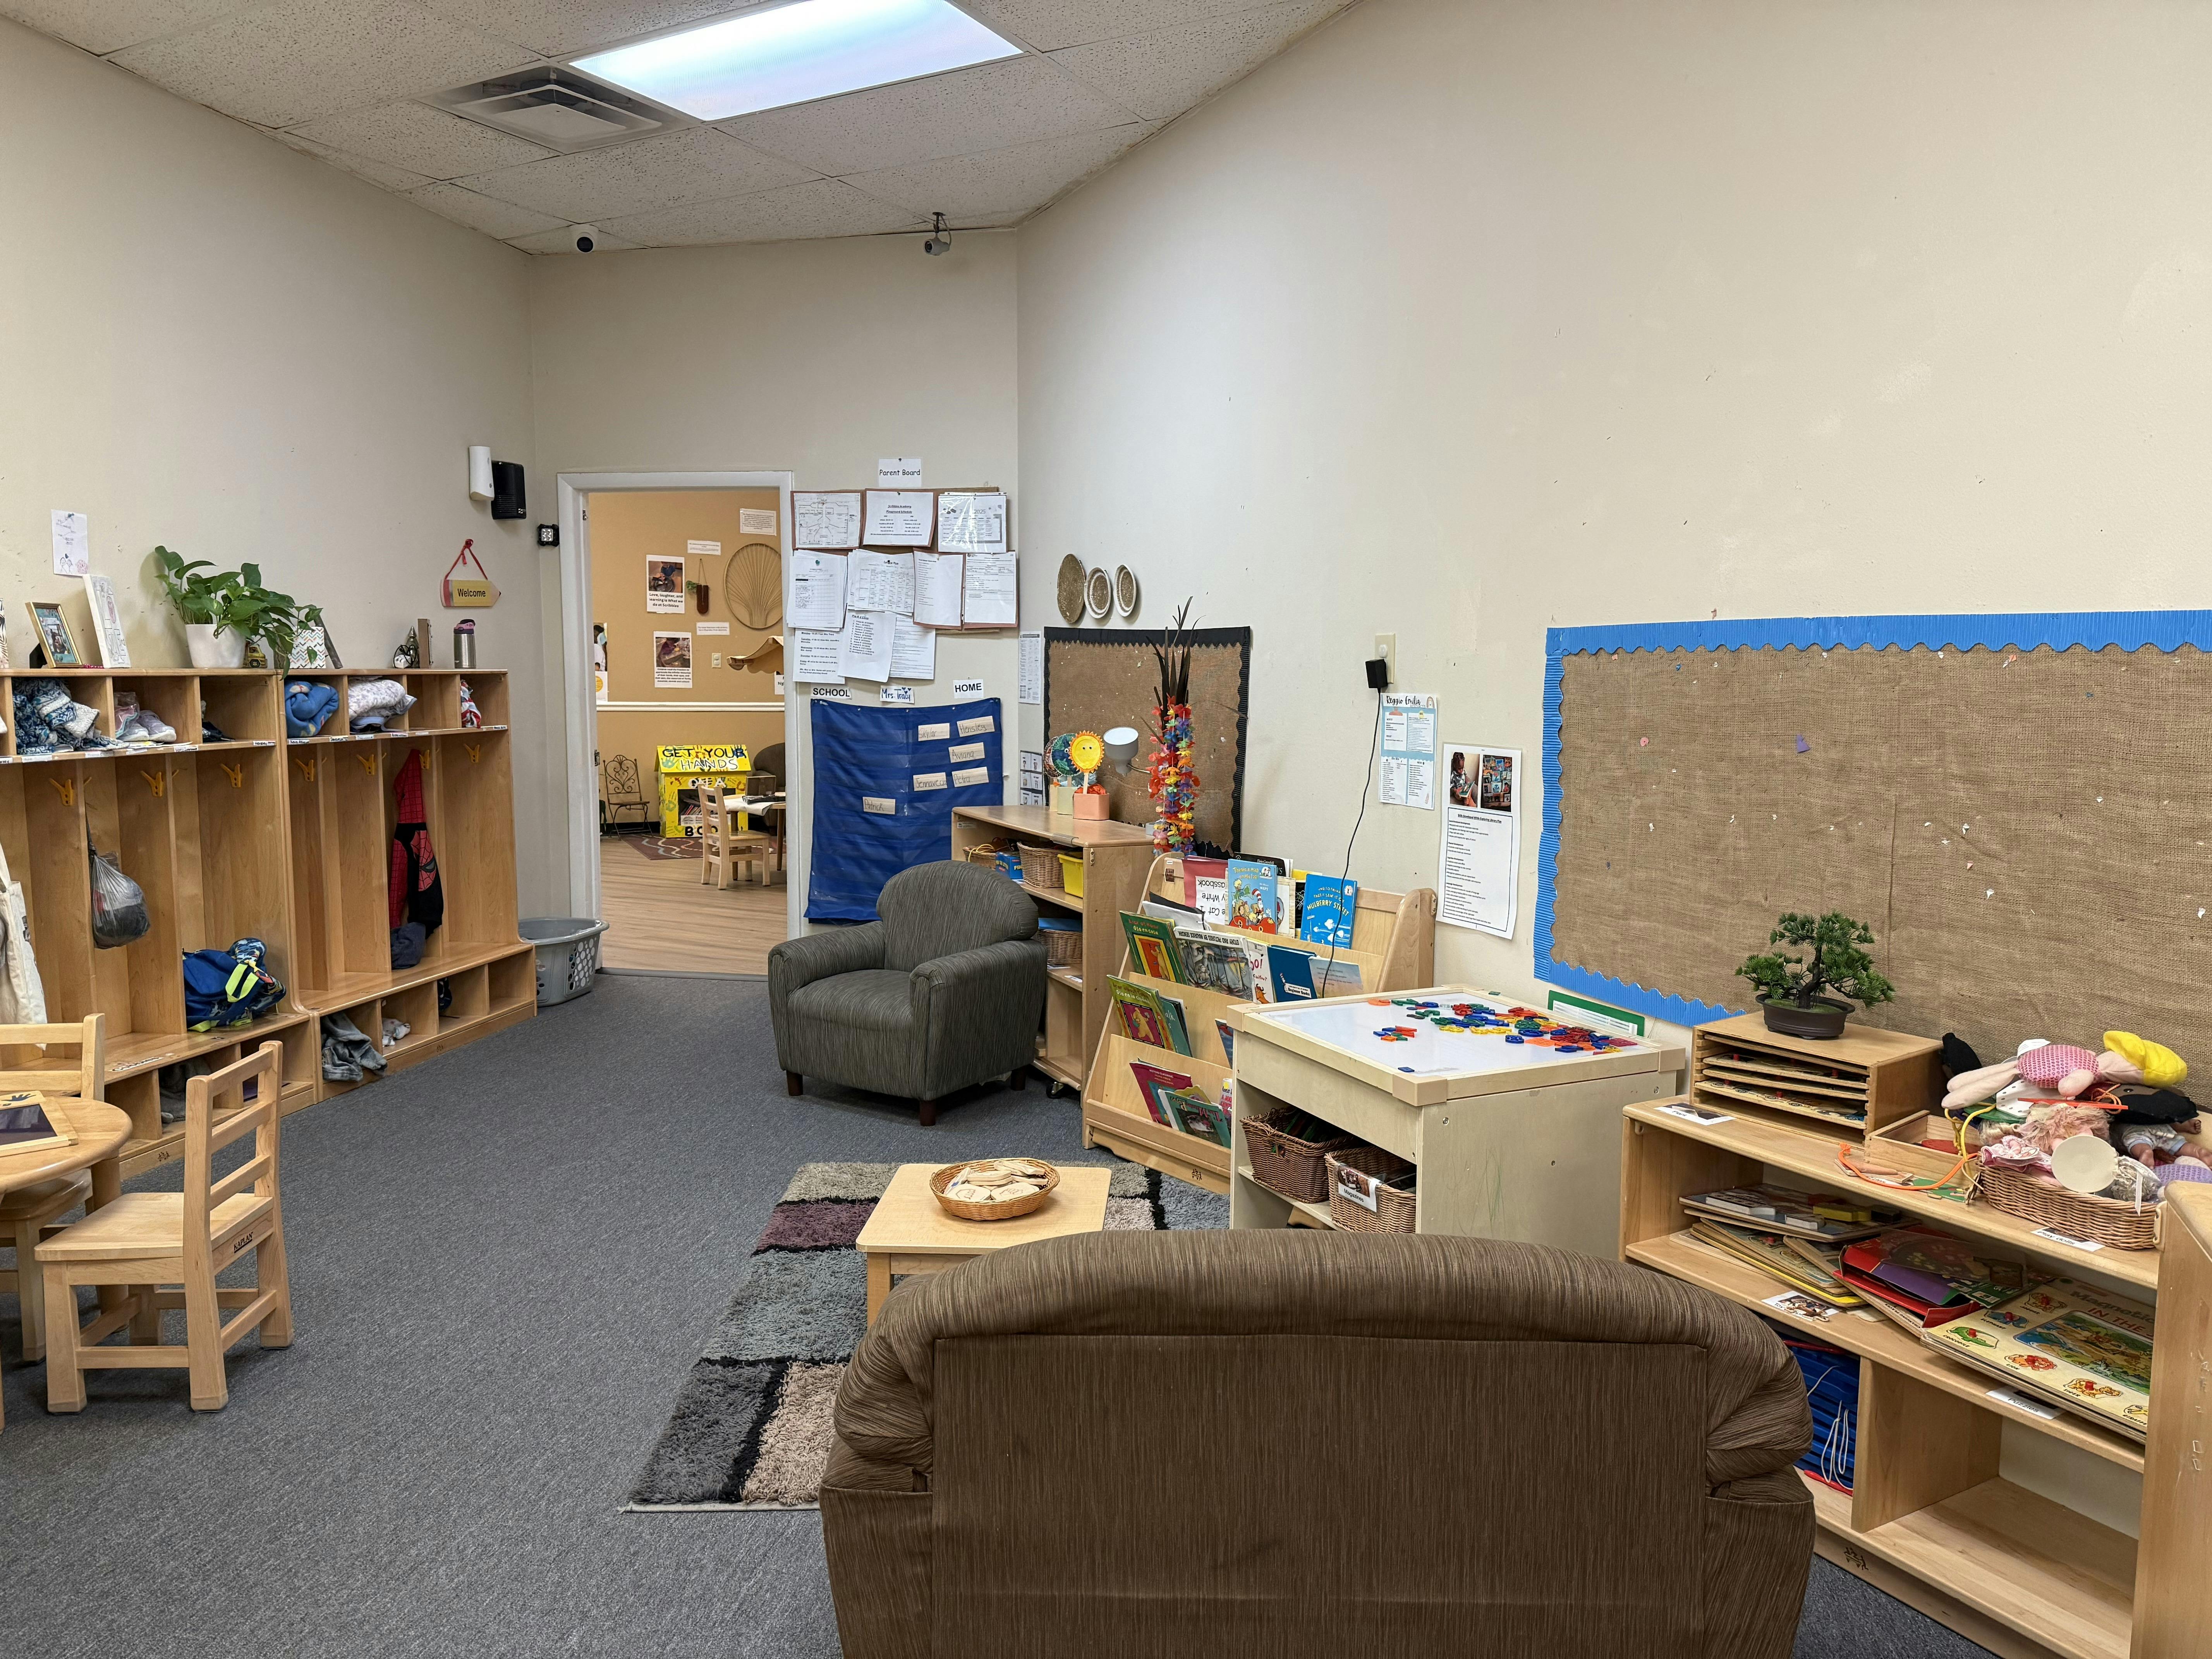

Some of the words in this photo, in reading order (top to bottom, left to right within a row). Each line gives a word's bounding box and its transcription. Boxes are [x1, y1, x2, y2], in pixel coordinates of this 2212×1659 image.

[457, 588, 486, 597] Welcome
[813, 688, 850, 697] SCHOOL
[955, 683, 982, 692] HOME
[882, 688, 895, 699] Mrs.
[894, 689, 910, 701] Tracy
[1386, 696, 1403, 707] Reggio
[1405, 696, 1421, 706] Emilia
[919, 727, 936, 738] Skylar
[960, 723, 987, 734] Hensley
[663, 748, 695, 757] GET
[704, 748, 747, 758] YOUR
[952, 749, 975, 760] Aviana
[681, 759, 738, 770] HANDS
[715, 777, 726, 788] A
[953, 773, 970, 785] Petra
[1198, 879, 1225, 889] assbook
[1202, 893, 1220, 902] White
[1208, 904, 1220, 916] Cat
[1307, 900, 1332, 911] MULBERRY
[1165, 1010, 1175, 1021] alk
[1344, 1188, 1364, 1202] Magazines
[234, 1232, 252, 1251] KAPLAN
[1981, 1318, 2007, 1329] ELEPHANT
[2087, 1307, 2109, 1318] IN
[2112, 1316, 2146, 1332] THE
[1943, 1335, 1970, 1348] CROCODILE
[2063, 1389, 2081, 1397] TIGER
[2008, 1397, 2039, 1413] Puzzles
